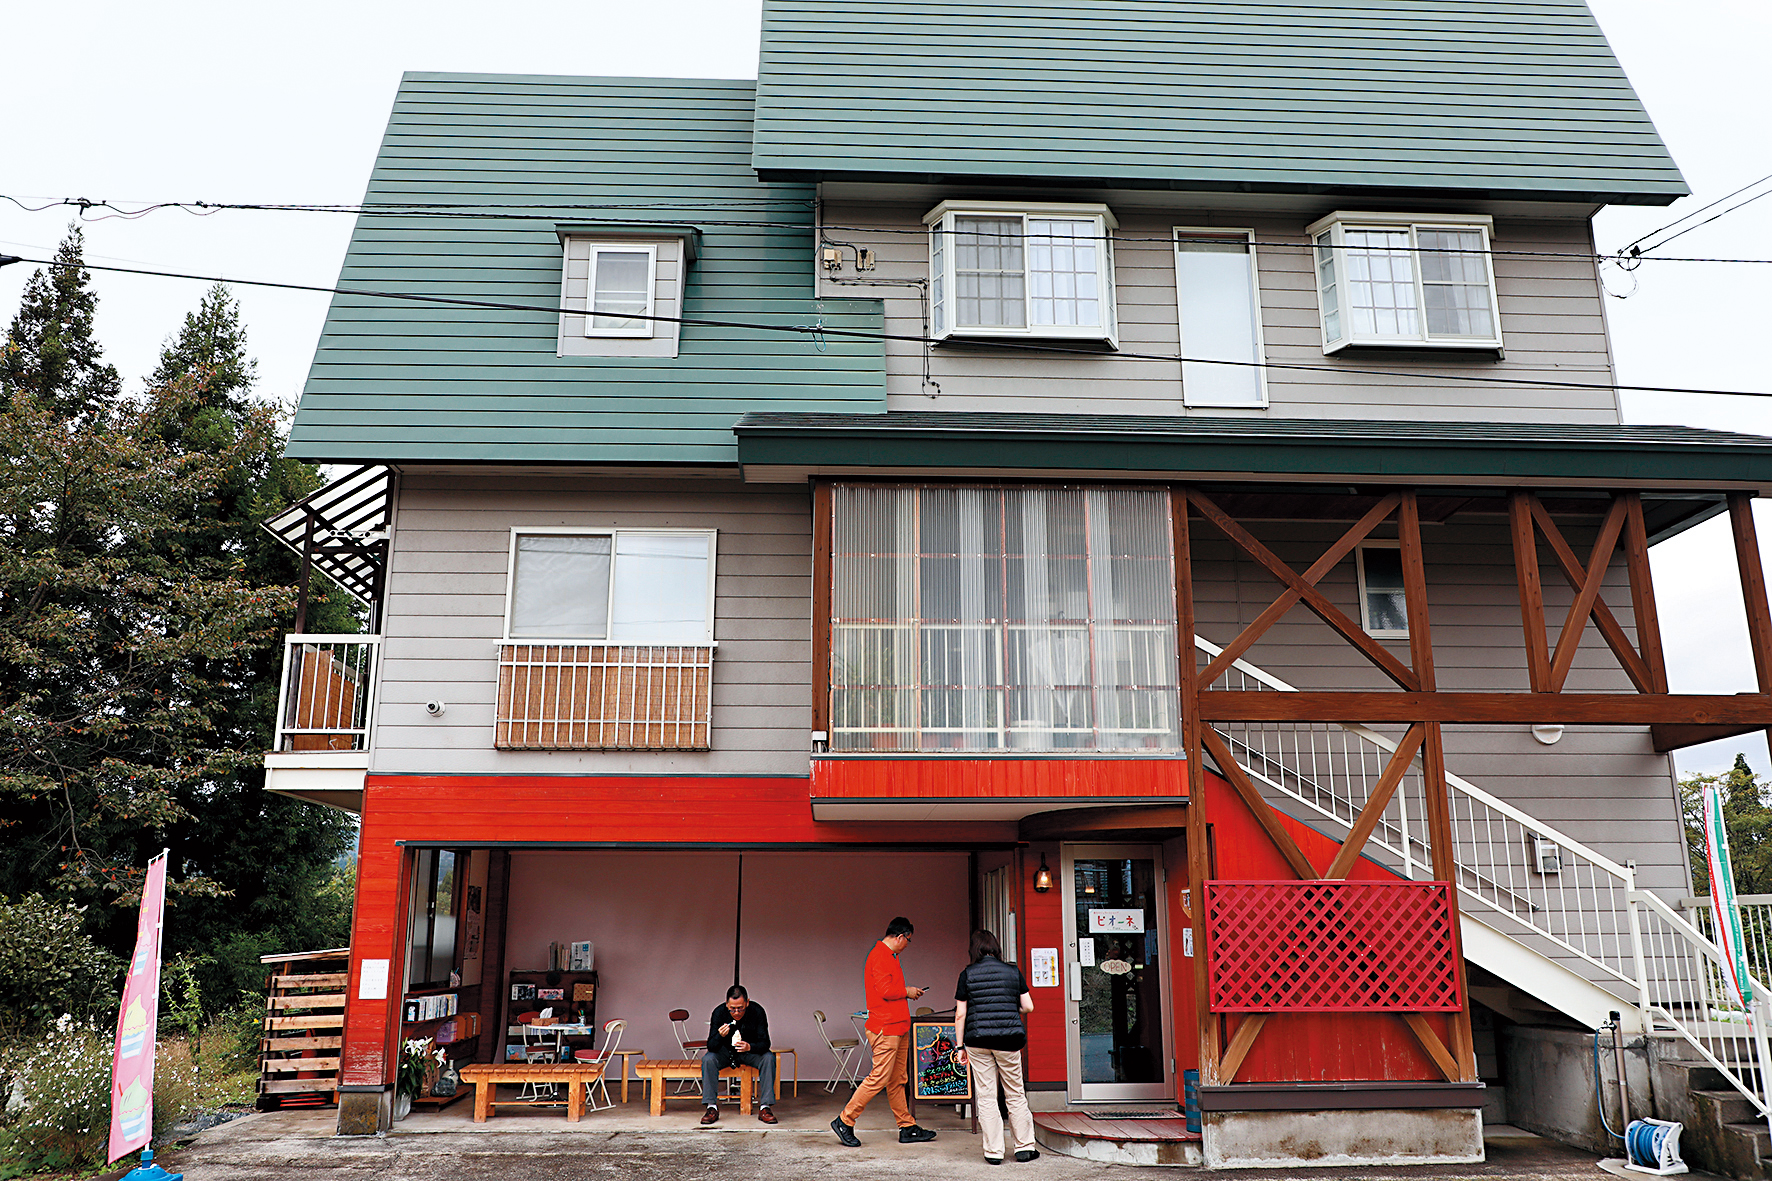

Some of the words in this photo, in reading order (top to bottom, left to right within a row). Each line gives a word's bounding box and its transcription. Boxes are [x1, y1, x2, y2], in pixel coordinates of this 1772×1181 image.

[1097, 915, 1135, 927] ピオーネ
[1103, 961, 1128, 972] OPEN
